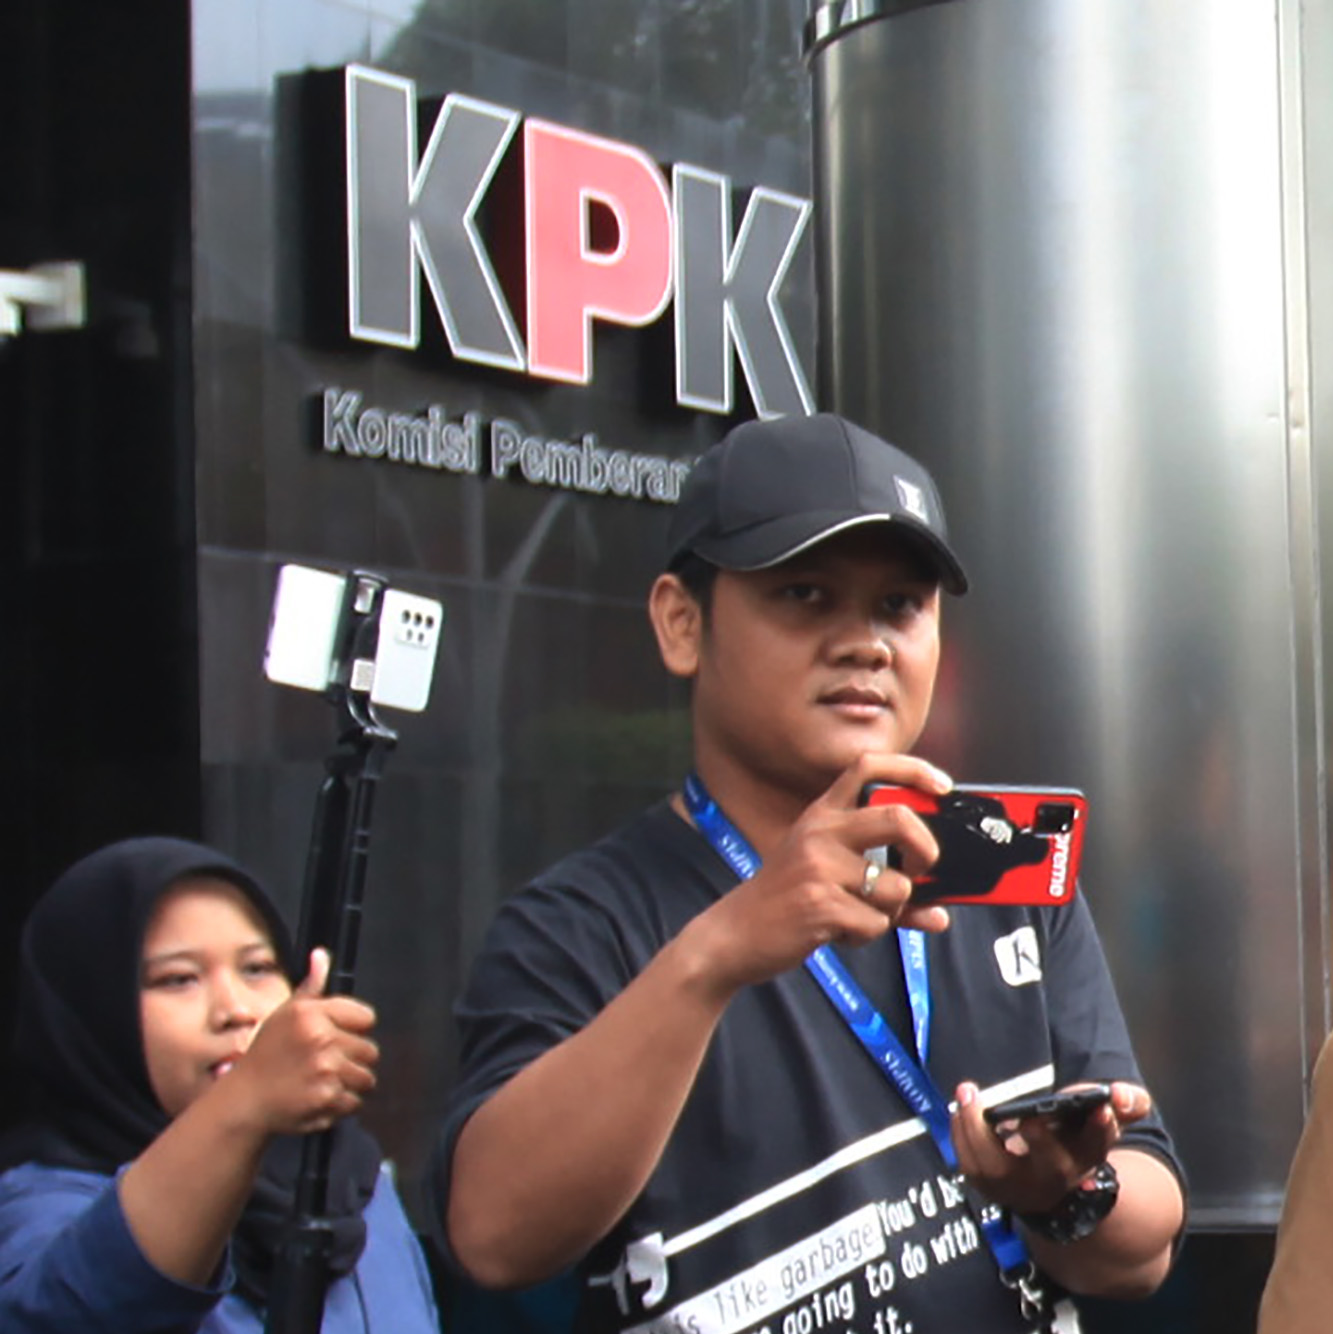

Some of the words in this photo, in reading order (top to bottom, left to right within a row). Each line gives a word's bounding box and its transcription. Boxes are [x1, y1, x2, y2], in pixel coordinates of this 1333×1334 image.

[346, 63, 815, 419] KPK
[324, 386, 481, 475] Komisi
[491, 419, 702, 503] Pemberan
[1049, 831, 1071, 897] preme
[714, 1279, 767, 1325] like
[876, 1180, 937, 1236] You'd
[865, 1261, 894, 1298] to
[901, 1241, 928, 1279] do
[930, 1216, 979, 1265] with
